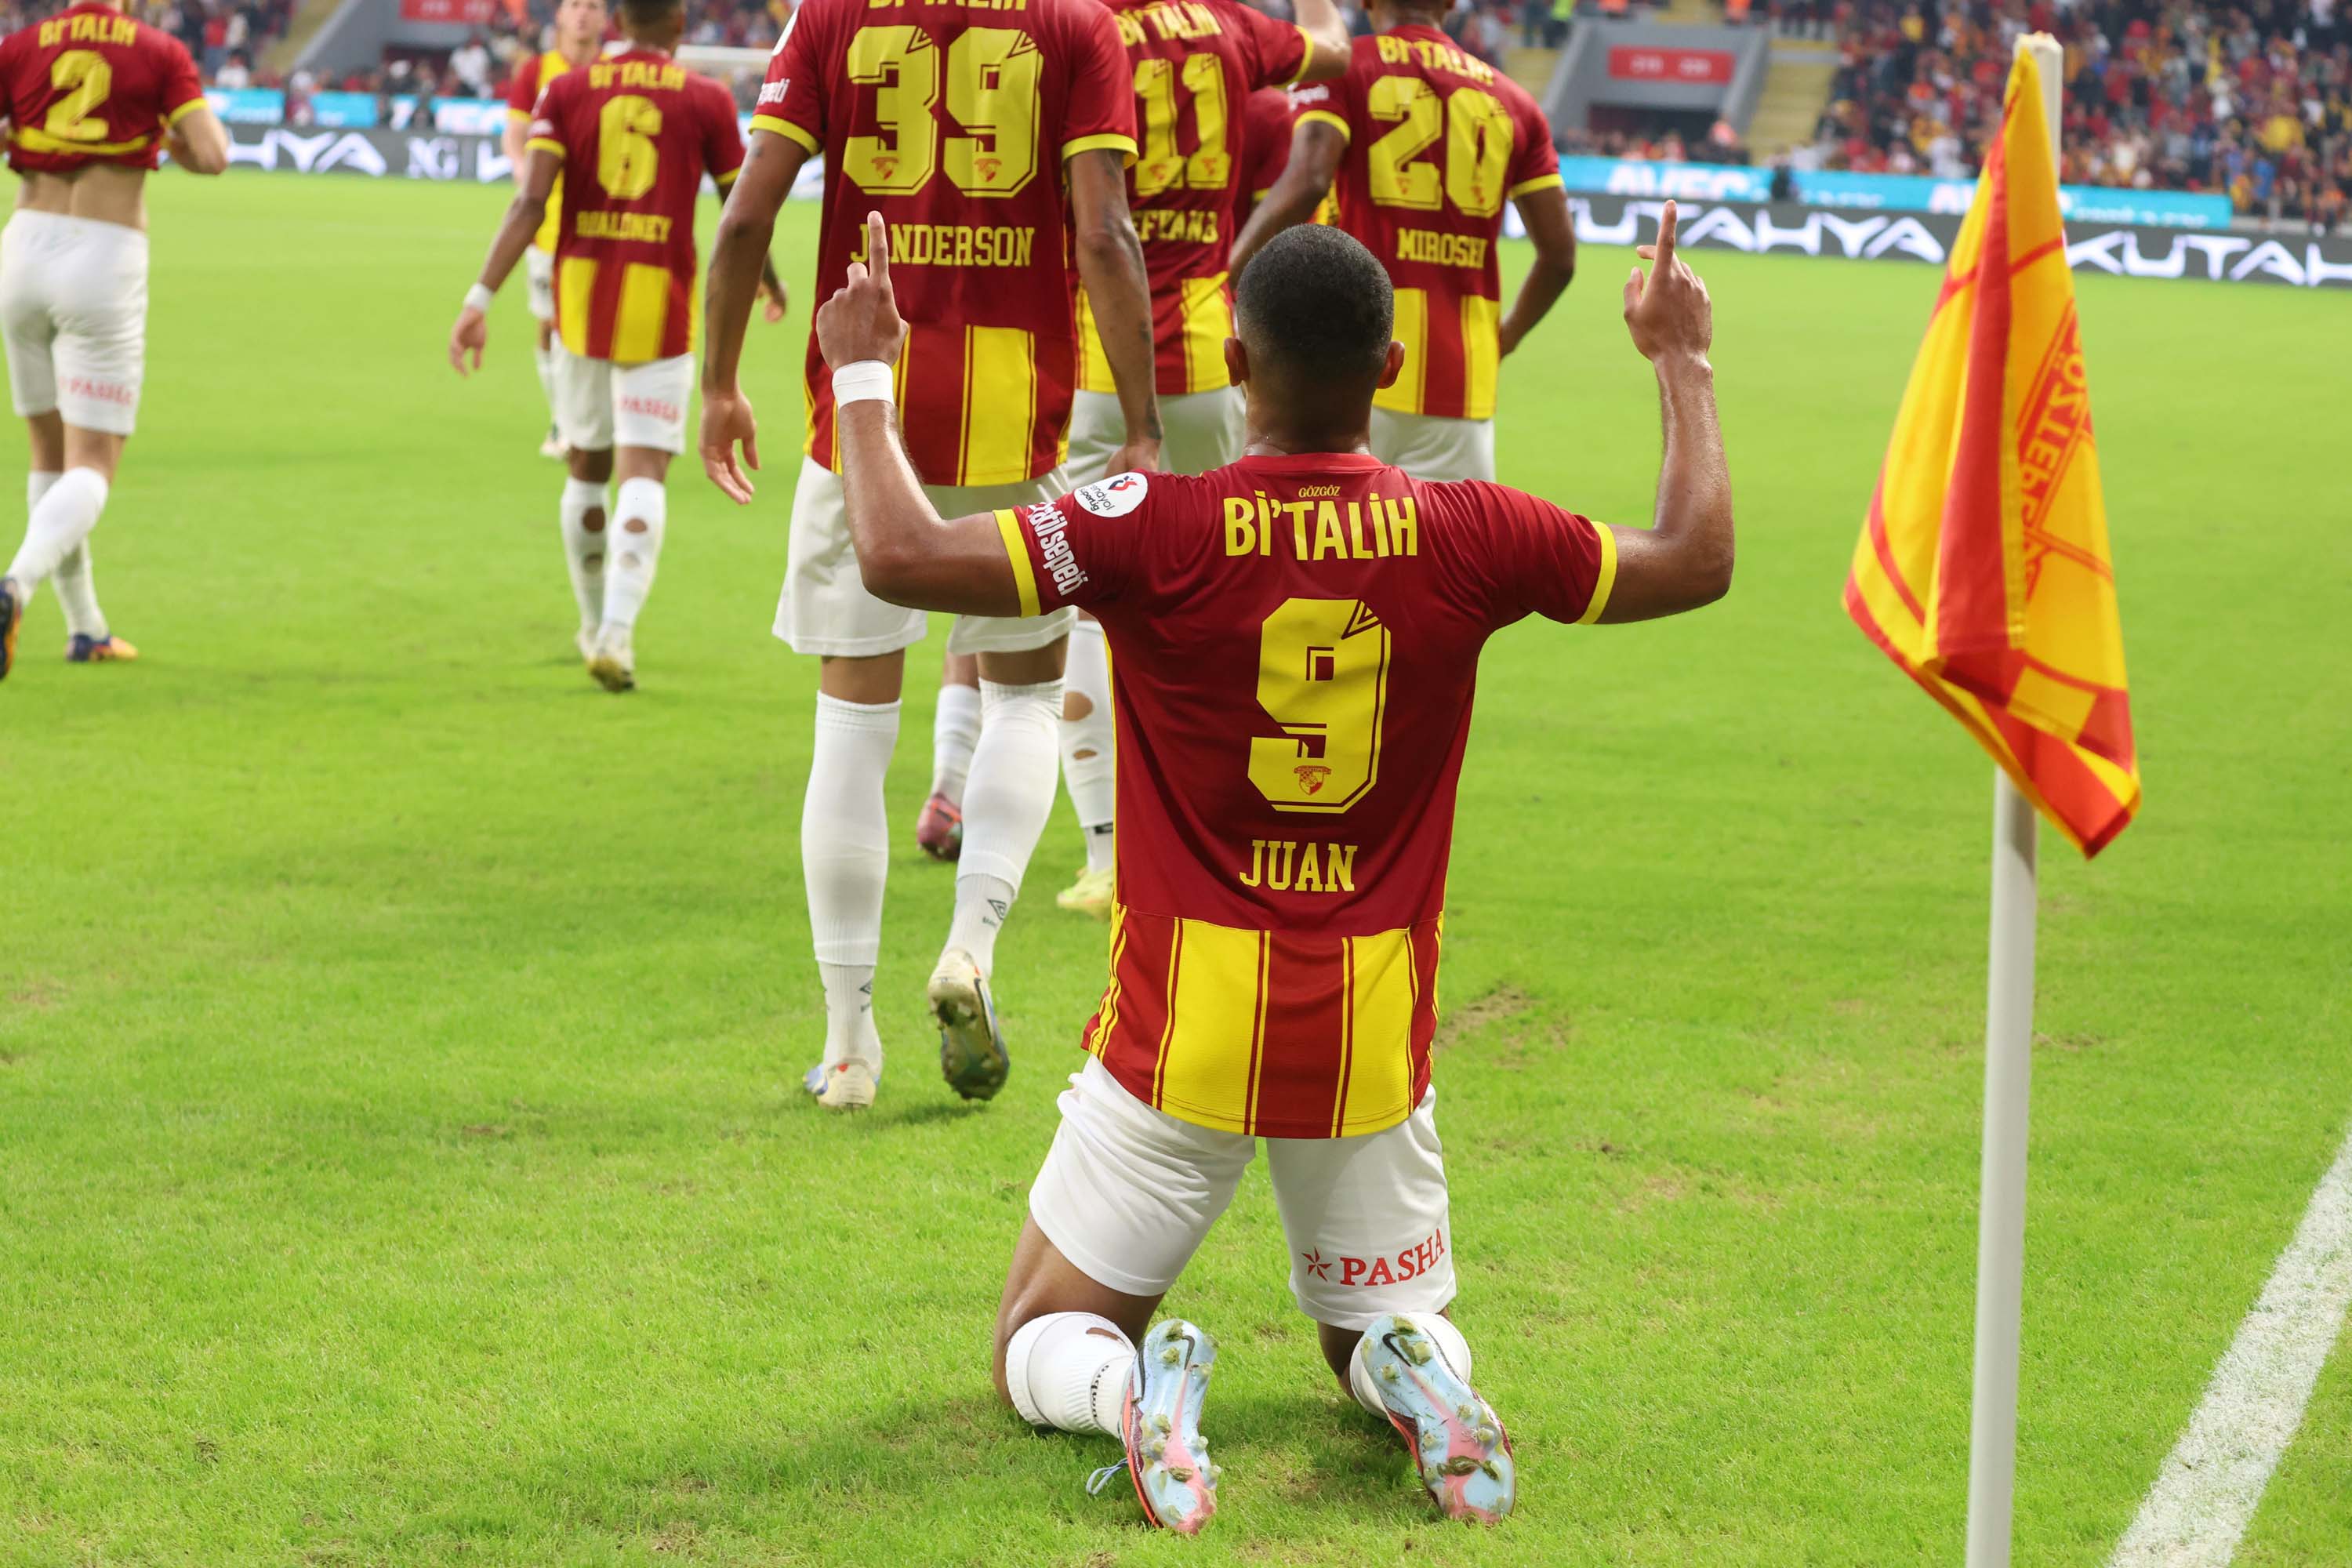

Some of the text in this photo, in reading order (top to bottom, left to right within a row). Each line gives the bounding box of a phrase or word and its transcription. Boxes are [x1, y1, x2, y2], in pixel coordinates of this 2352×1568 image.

[44, 50, 111, 141] 2
[842, 24, 1044, 198] 39
[1133, 53, 1232, 197] 11
[597, 94, 662, 201] 6
[1367, 74, 1515, 219] 20
[849, 223, 1035, 267] JNDERSON
[1223, 491, 1417, 561] Bİ'TALİH
[1298, 485, 1341, 498] GÖZGÖZ
[1247, 597, 1391, 814] 9
[1239, 840, 1358, 892] JUAN
[1339, 1228, 1446, 1287] PASHA
